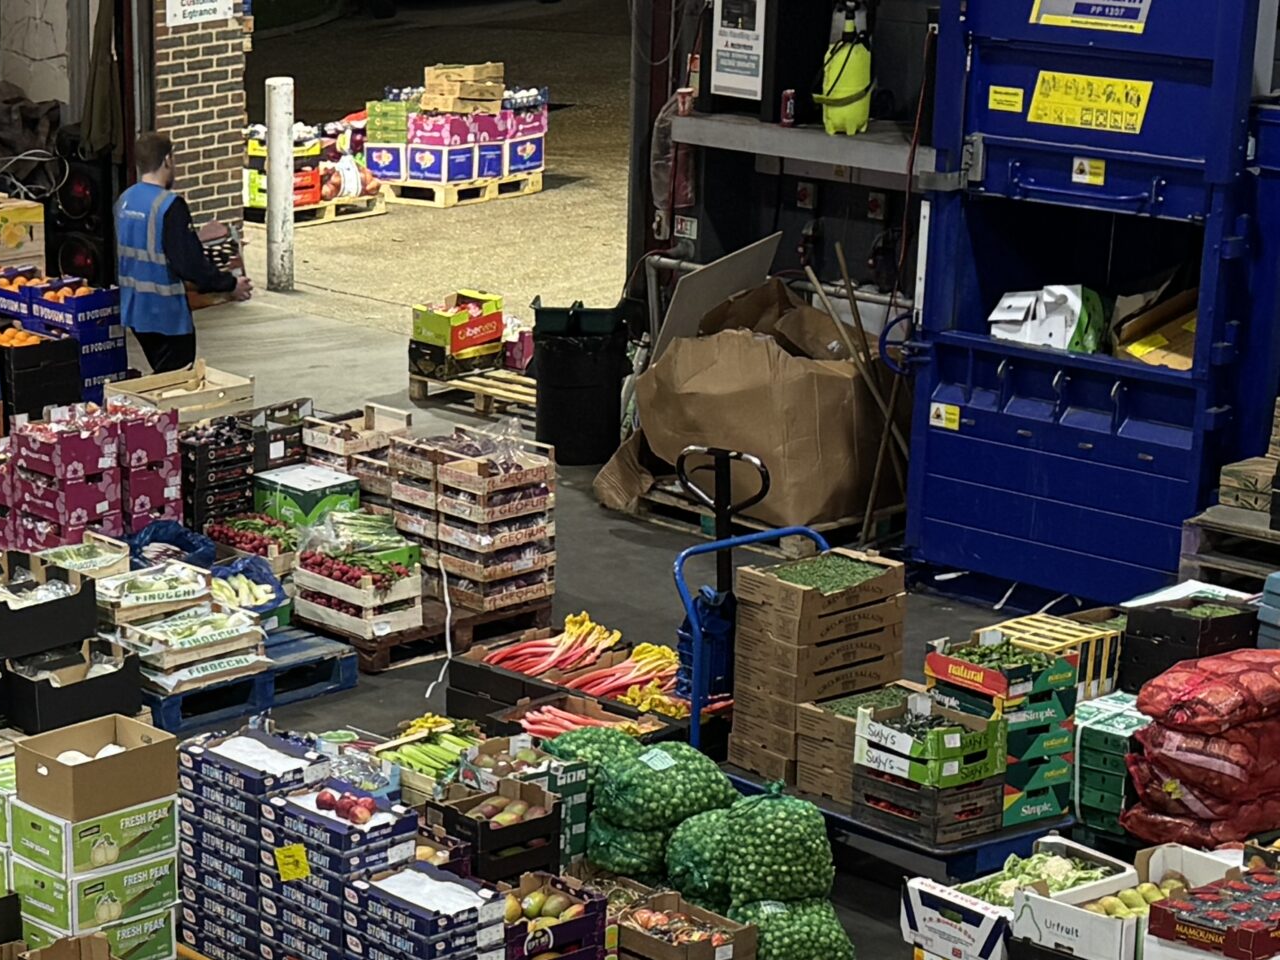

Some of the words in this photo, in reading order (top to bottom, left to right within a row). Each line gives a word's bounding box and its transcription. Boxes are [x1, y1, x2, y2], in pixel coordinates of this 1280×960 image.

[182, 6, 218, 19] Entrance
[135, 590, 195, 601] FINOCCHI
[180, 629, 240, 647] FINOCCHI
[188, 658, 249, 675] FINOCCHI
[948, 664, 984, 683] natural
[202, 763, 224, 781] STONE
[225, 772, 245, 790] FRUIT
[120, 813, 146, 830] FRESH
[147, 807, 169, 822] PEAR
[204, 809, 225, 826] STONE
[227, 816, 247, 835] FRUIT
[284, 816, 307, 834] STONE
[309, 826, 330, 844] FRUIT
[123, 872, 148, 886] FRESH
[149, 863, 170, 879] PEAR
[368, 900, 392, 921] STONE
[394, 909, 415, 930] FRUIT
[1045, 918, 1080, 938] Urfruit
[1176, 923, 1225, 945] MAMOUNIA
